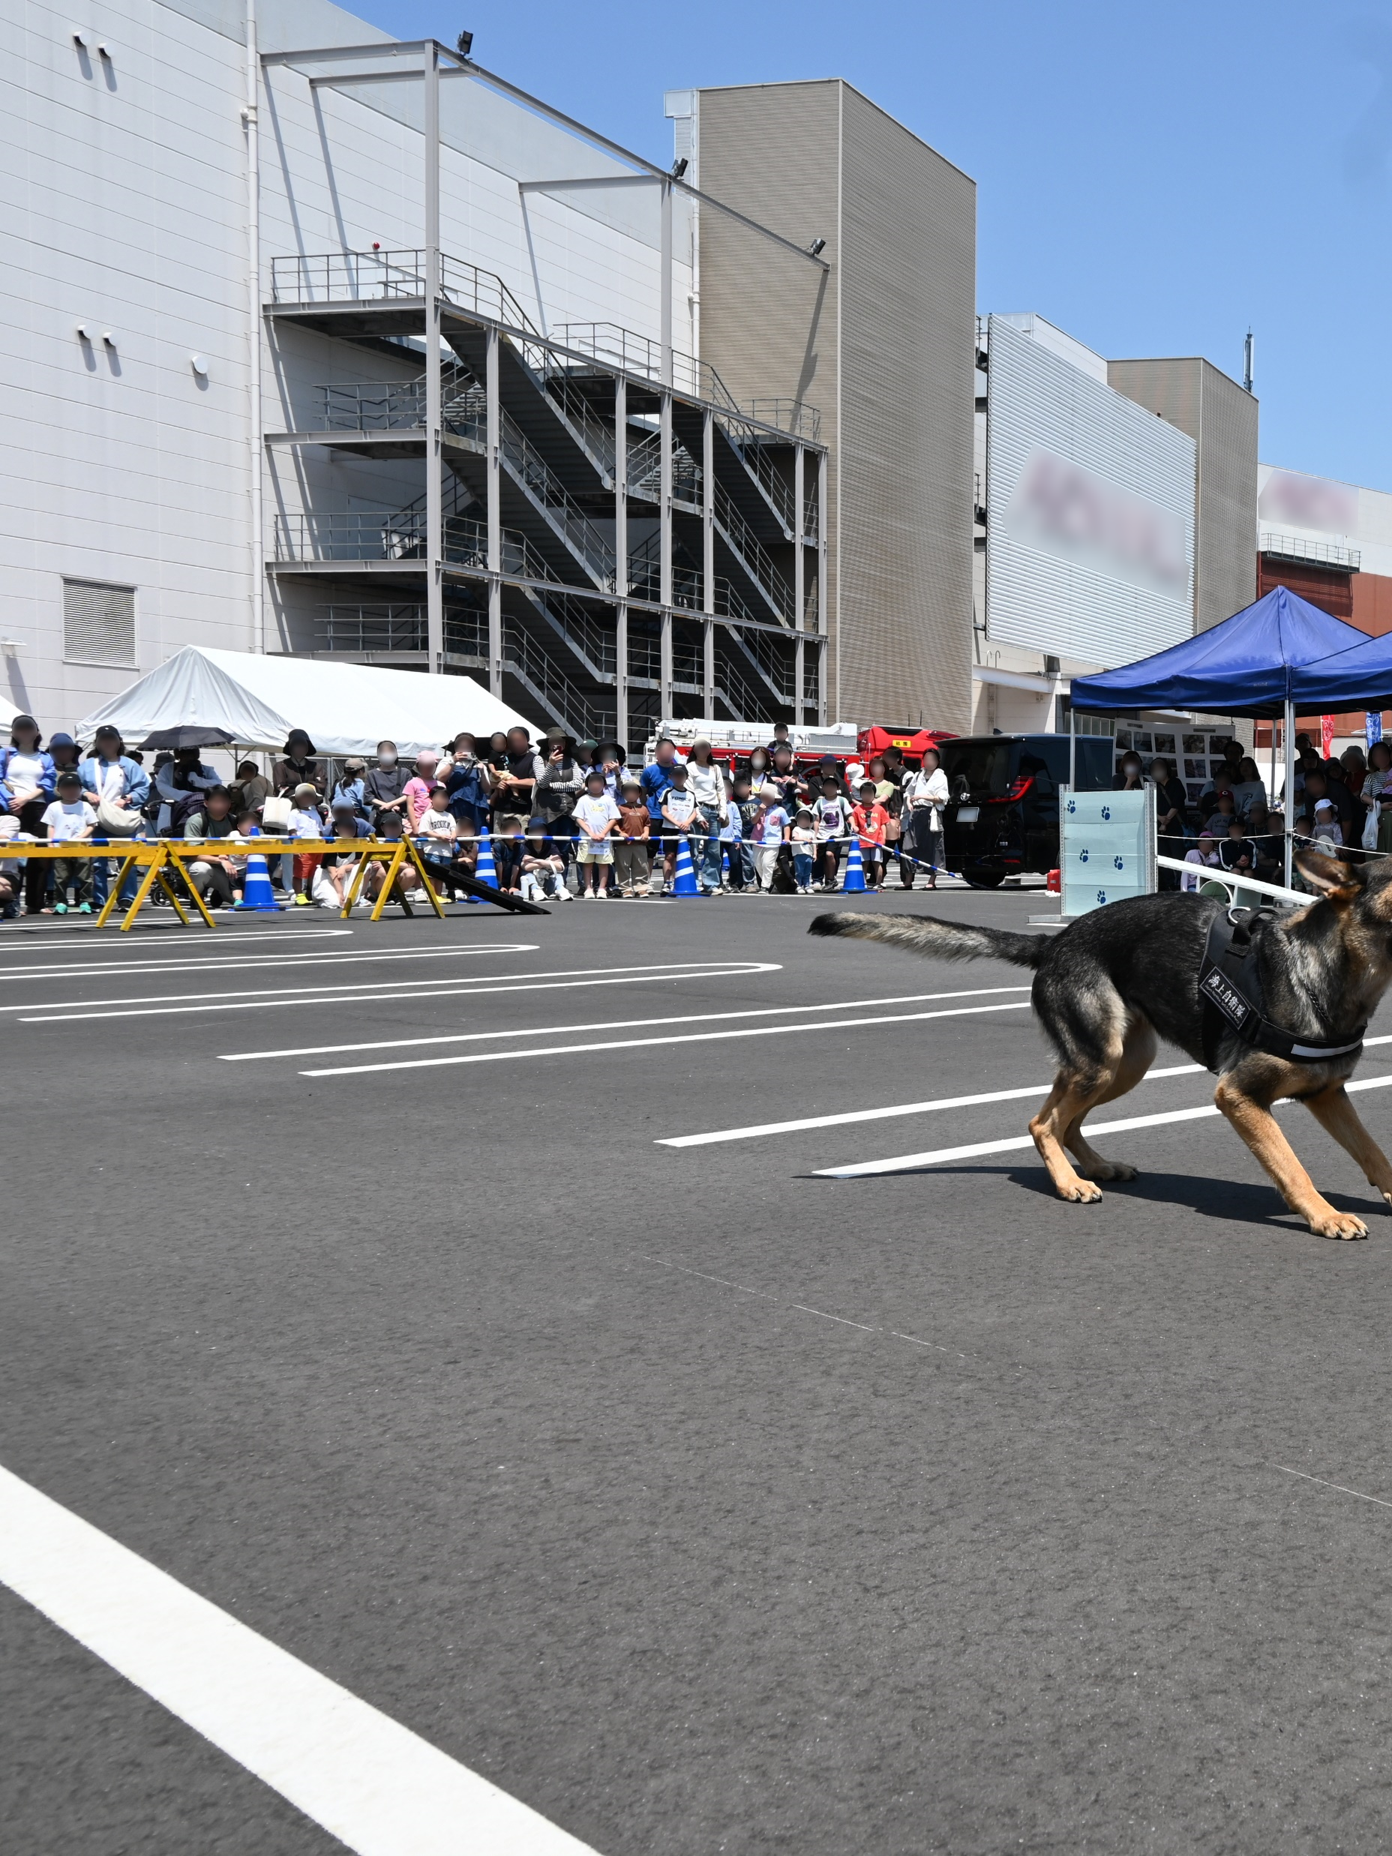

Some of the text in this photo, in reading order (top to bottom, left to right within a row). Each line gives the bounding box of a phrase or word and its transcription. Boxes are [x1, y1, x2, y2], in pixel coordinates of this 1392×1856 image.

[1208, 974, 1246, 1019] 海上自衛隊
